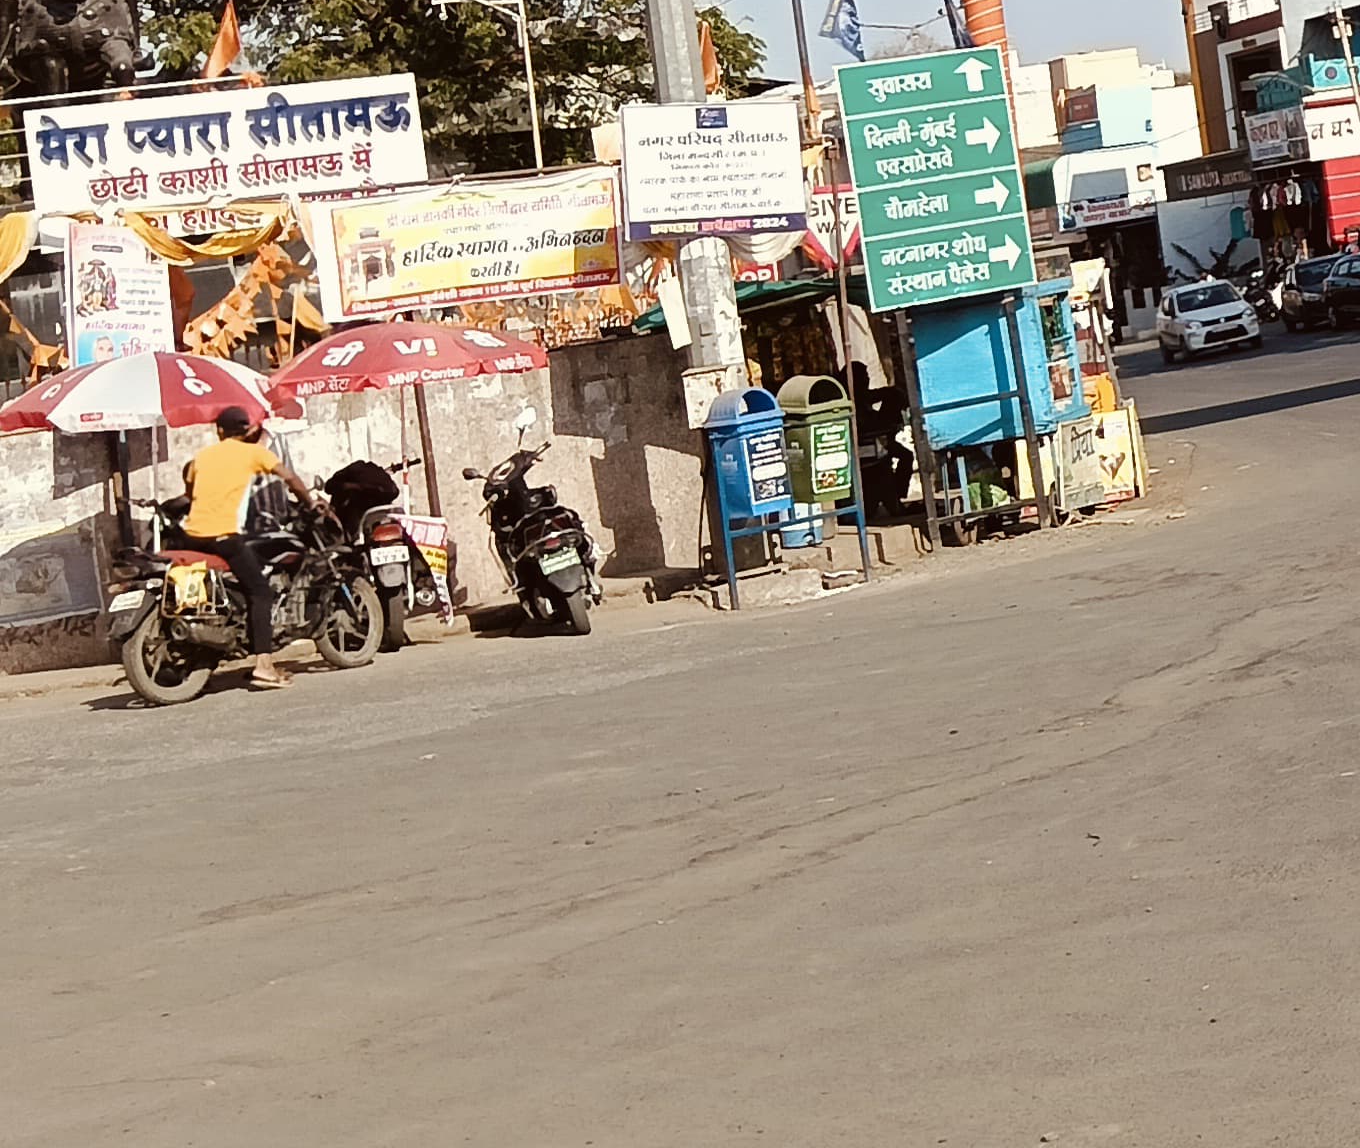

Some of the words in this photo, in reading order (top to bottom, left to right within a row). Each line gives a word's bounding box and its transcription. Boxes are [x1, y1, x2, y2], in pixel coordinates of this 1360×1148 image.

[866, 71, 932, 103] सुवासरा
[36, 115, 109, 169] मेरा
[123, 111, 231, 157] प्यारा
[246, 91, 411, 148] सीतामऊ
[863, 112, 957, 150] दिल्ली-मुंबई
[88, 167, 149, 203] छोटी
[158, 158, 229, 196] काशी
[239, 151, 343, 187] सीतामऊ
[353, 141, 373, 172] में
[809, 197, 857, 218] GIVE
[883, 190, 949, 220] चौमहेला
[817, 220, 850, 234] WAY
[879, 240, 950, 267] नटनागर
[886, 271, 947, 296] संस्थान
[946, 259, 991, 285] पैलेस
[297, 381, 325, 396] MNP
[387, 371, 420, 386] MNP
[420, 367, 465, 382] Center
